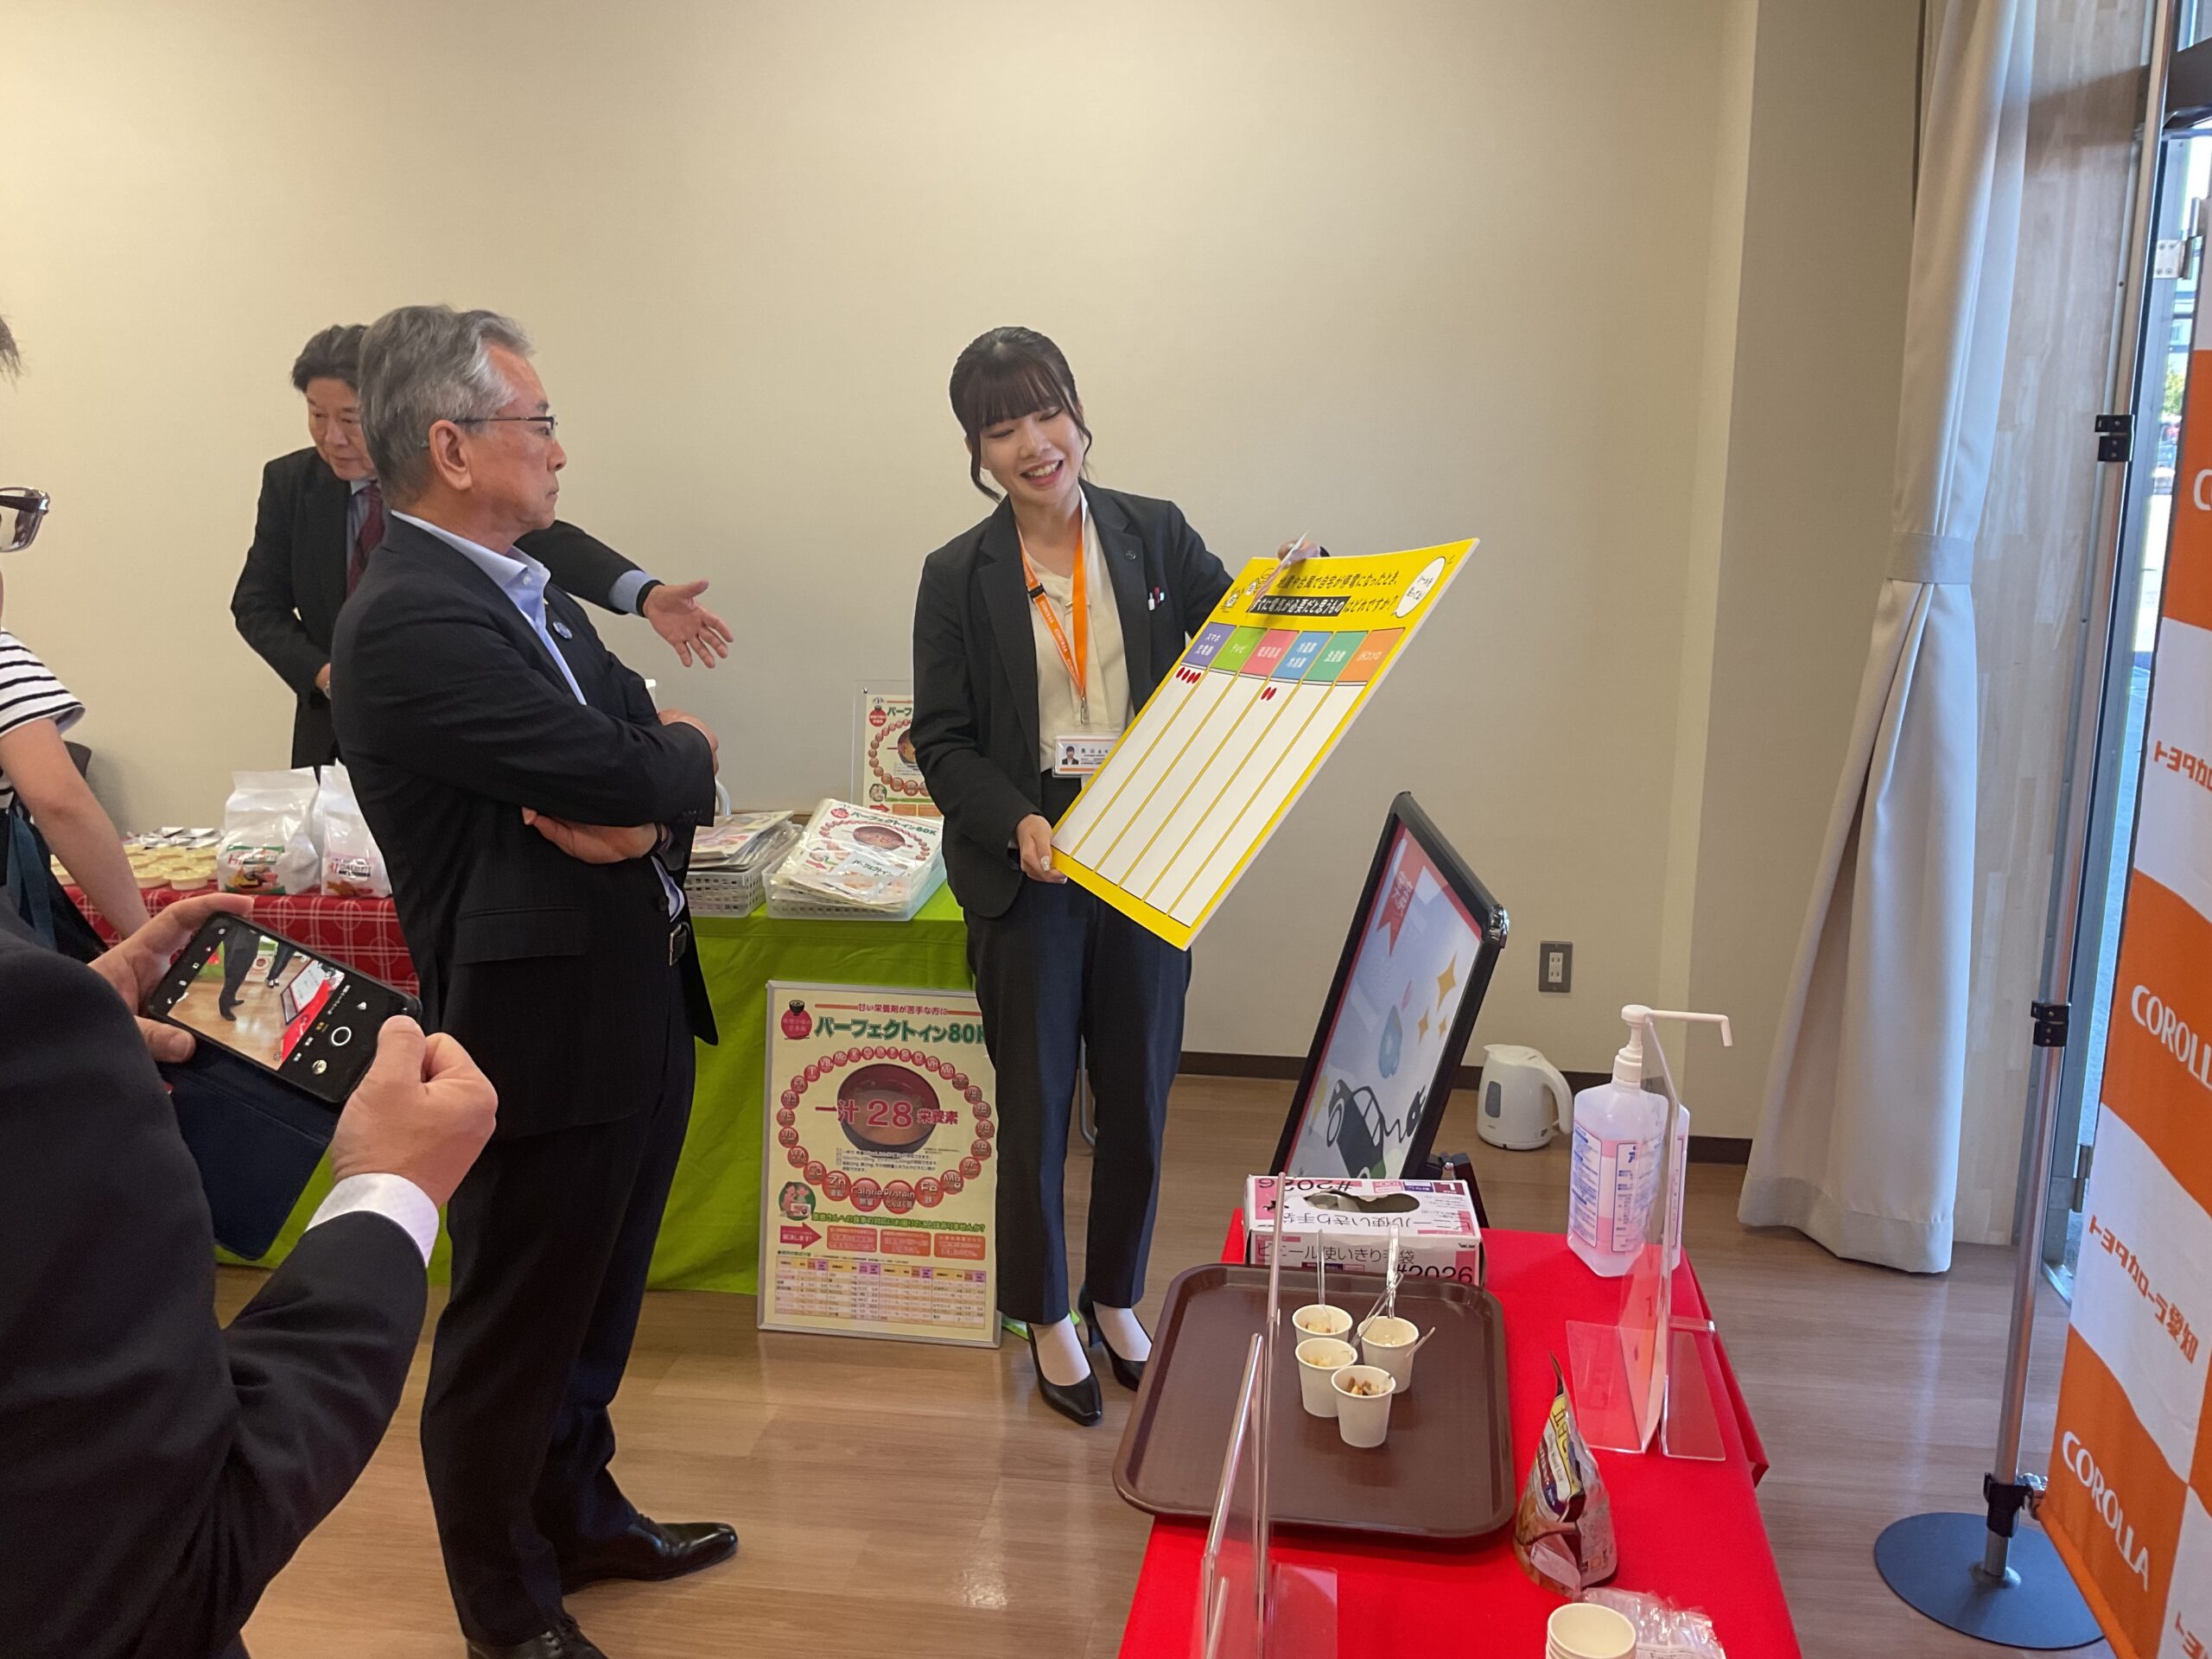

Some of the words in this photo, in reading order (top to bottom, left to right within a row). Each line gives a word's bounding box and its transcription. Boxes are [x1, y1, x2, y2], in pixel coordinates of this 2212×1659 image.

[857, 1002, 948, 1016] 甘い栄養剤が苦手な方に
[1257, 1243, 1415, 1265] ビール使いきり袋
[2089, 1214, 2199, 1364] トヨタカローラ愛知
[2063, 1431, 2149, 1592] COROLLA
